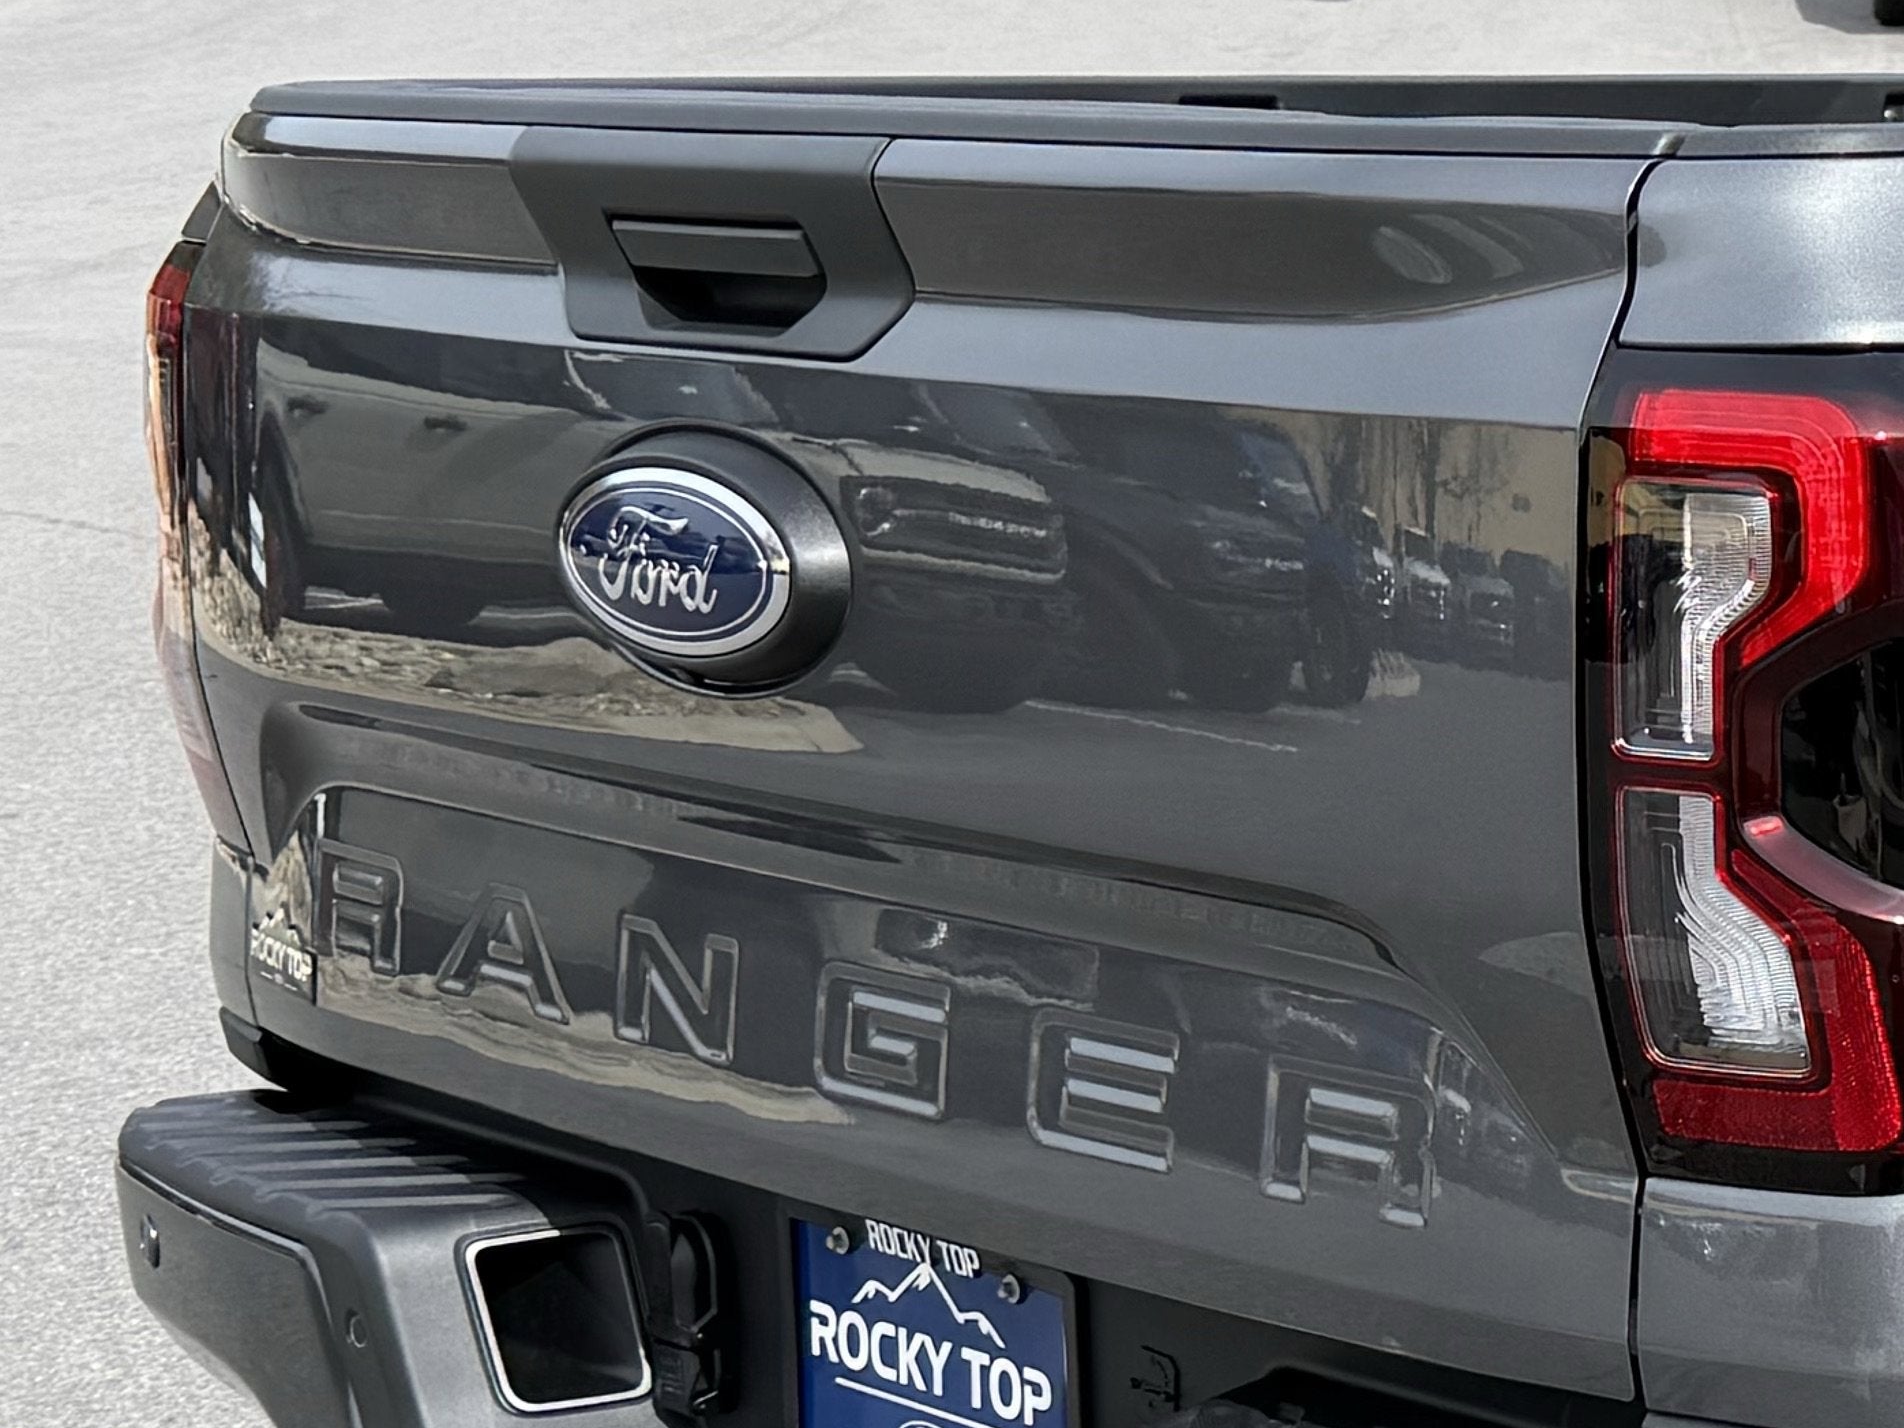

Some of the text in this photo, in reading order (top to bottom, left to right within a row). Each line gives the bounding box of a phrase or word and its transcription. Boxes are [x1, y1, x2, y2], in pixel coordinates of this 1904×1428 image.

[597, 505, 719, 615] Ford
[250, 928, 313, 982] ROCKY TOP
[312, 836, 1437, 1228] RANGER
[864, 1218, 981, 1279] ROCKY TOP
[809, 1299, 1052, 1427] ROCKY TOP
